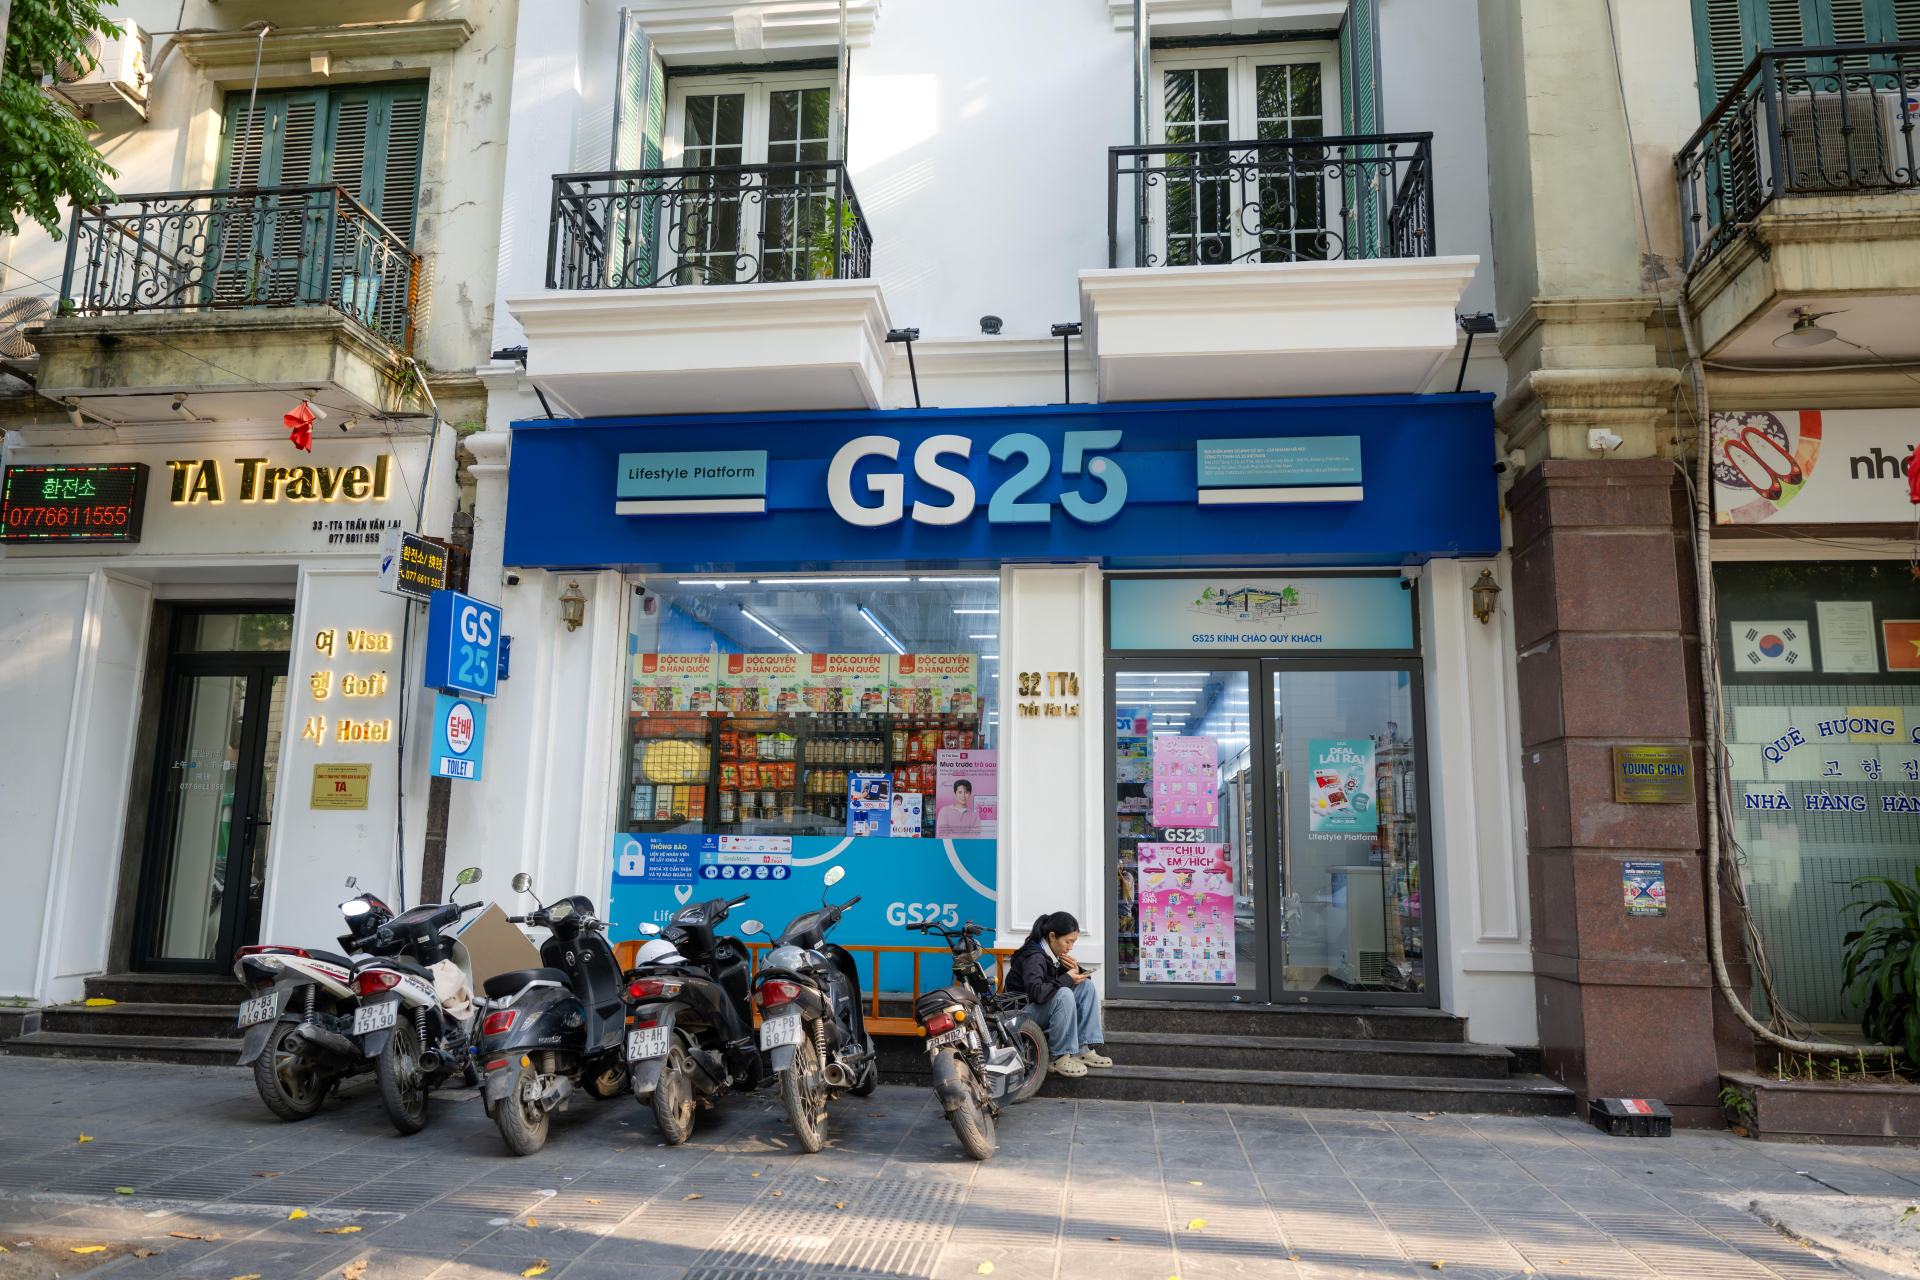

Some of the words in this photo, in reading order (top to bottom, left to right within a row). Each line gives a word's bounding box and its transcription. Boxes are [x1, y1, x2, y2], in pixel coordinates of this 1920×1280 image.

[165, 459, 223, 502] TA
[234, 454, 390, 500] Travel
[628, 467, 688, 482] Lifestyle
[694, 465, 755, 478] Platform
[827, 430, 1128, 527] GS25
[42, 478, 96, 499] 환전소
[10, 507, 128, 526] 0776611555
[329, 533, 344, 543] 077
[346, 533, 363, 543] 6611
[365, 533, 379, 543] 555
[405, 571, 417, 582] 077
[417, 573, 430, 586] 6611
[431, 577, 441, 589] 555
[460, 605, 492, 647] GS
[346, 630, 390, 651] Visa
[1191, 634, 1215, 643] GS25
[1217, 632, 1239, 643] KÍNH
[1241, 632, 1267, 643] CHÀO
[1269, 632, 1288, 643] QUÝ
[1291, 632, 1322, 643] KHÁCH
[458, 644, 489, 687] 25
[660, 655, 679, 665] ĐỘC
[667, 664, 686, 672] HÀN
[686, 663, 709, 673] QUỐC
[746, 655, 765, 666] ĐỘC
[753, 665, 772, 673] HÀN
[772, 663, 796, 673] QUỐC
[829, 655, 848, 665] ĐỘC
[836, 664, 855, 673] HÀN
[856, 663, 880, 673] QUỐC
[917, 655, 937, 666] ĐỘC
[925, 665, 944, 673] HÀN
[944, 663, 969, 673] QUỐC
[1018, 671, 1042, 697] 32
[1047, 671, 1080, 697] TT4
[1018, 700, 1040, 716] Trần
[1043, 702, 1062, 716] Văn
[1064, 703, 1080, 716] Lai
[336, 719, 390, 741] Hotel
[450, 716, 472, 741] 담배
[1764, 726, 1807, 764] QUÊ
[1817, 715, 1896, 738] HƯƠNG
[1329, 747, 1354, 755] DEAL
[447, 758, 468, 777] TOILET
[1319, 754, 1340, 764] LAI
[1342, 754, 1365, 765] RAI
[1621, 763, 1655, 775] YOUNG
[1657, 763, 1685, 775] CHAN
[334, 781, 347, 792] TA
[1744, 788, 1792, 810] NHÀ
[1804, 789, 1867, 811] HÀNG
[1165, 828, 1205, 842] GS25
[1308, 833, 1342, 842] Lifestyle
[1344, 833, 1378, 841] Platform
[1195, 846, 1206, 854] IU
[1167, 857, 1181, 866] EM
[886, 902, 959, 928] GS25
[360, 1003, 391, 1019] 29-Z1
[357, 1014, 394, 1032] 151.90
[765, 1017, 795, 1033] 37-P8
[633, 1028, 663, 1044] 29-AH
[630, 1041, 666, 1059] 241.32
